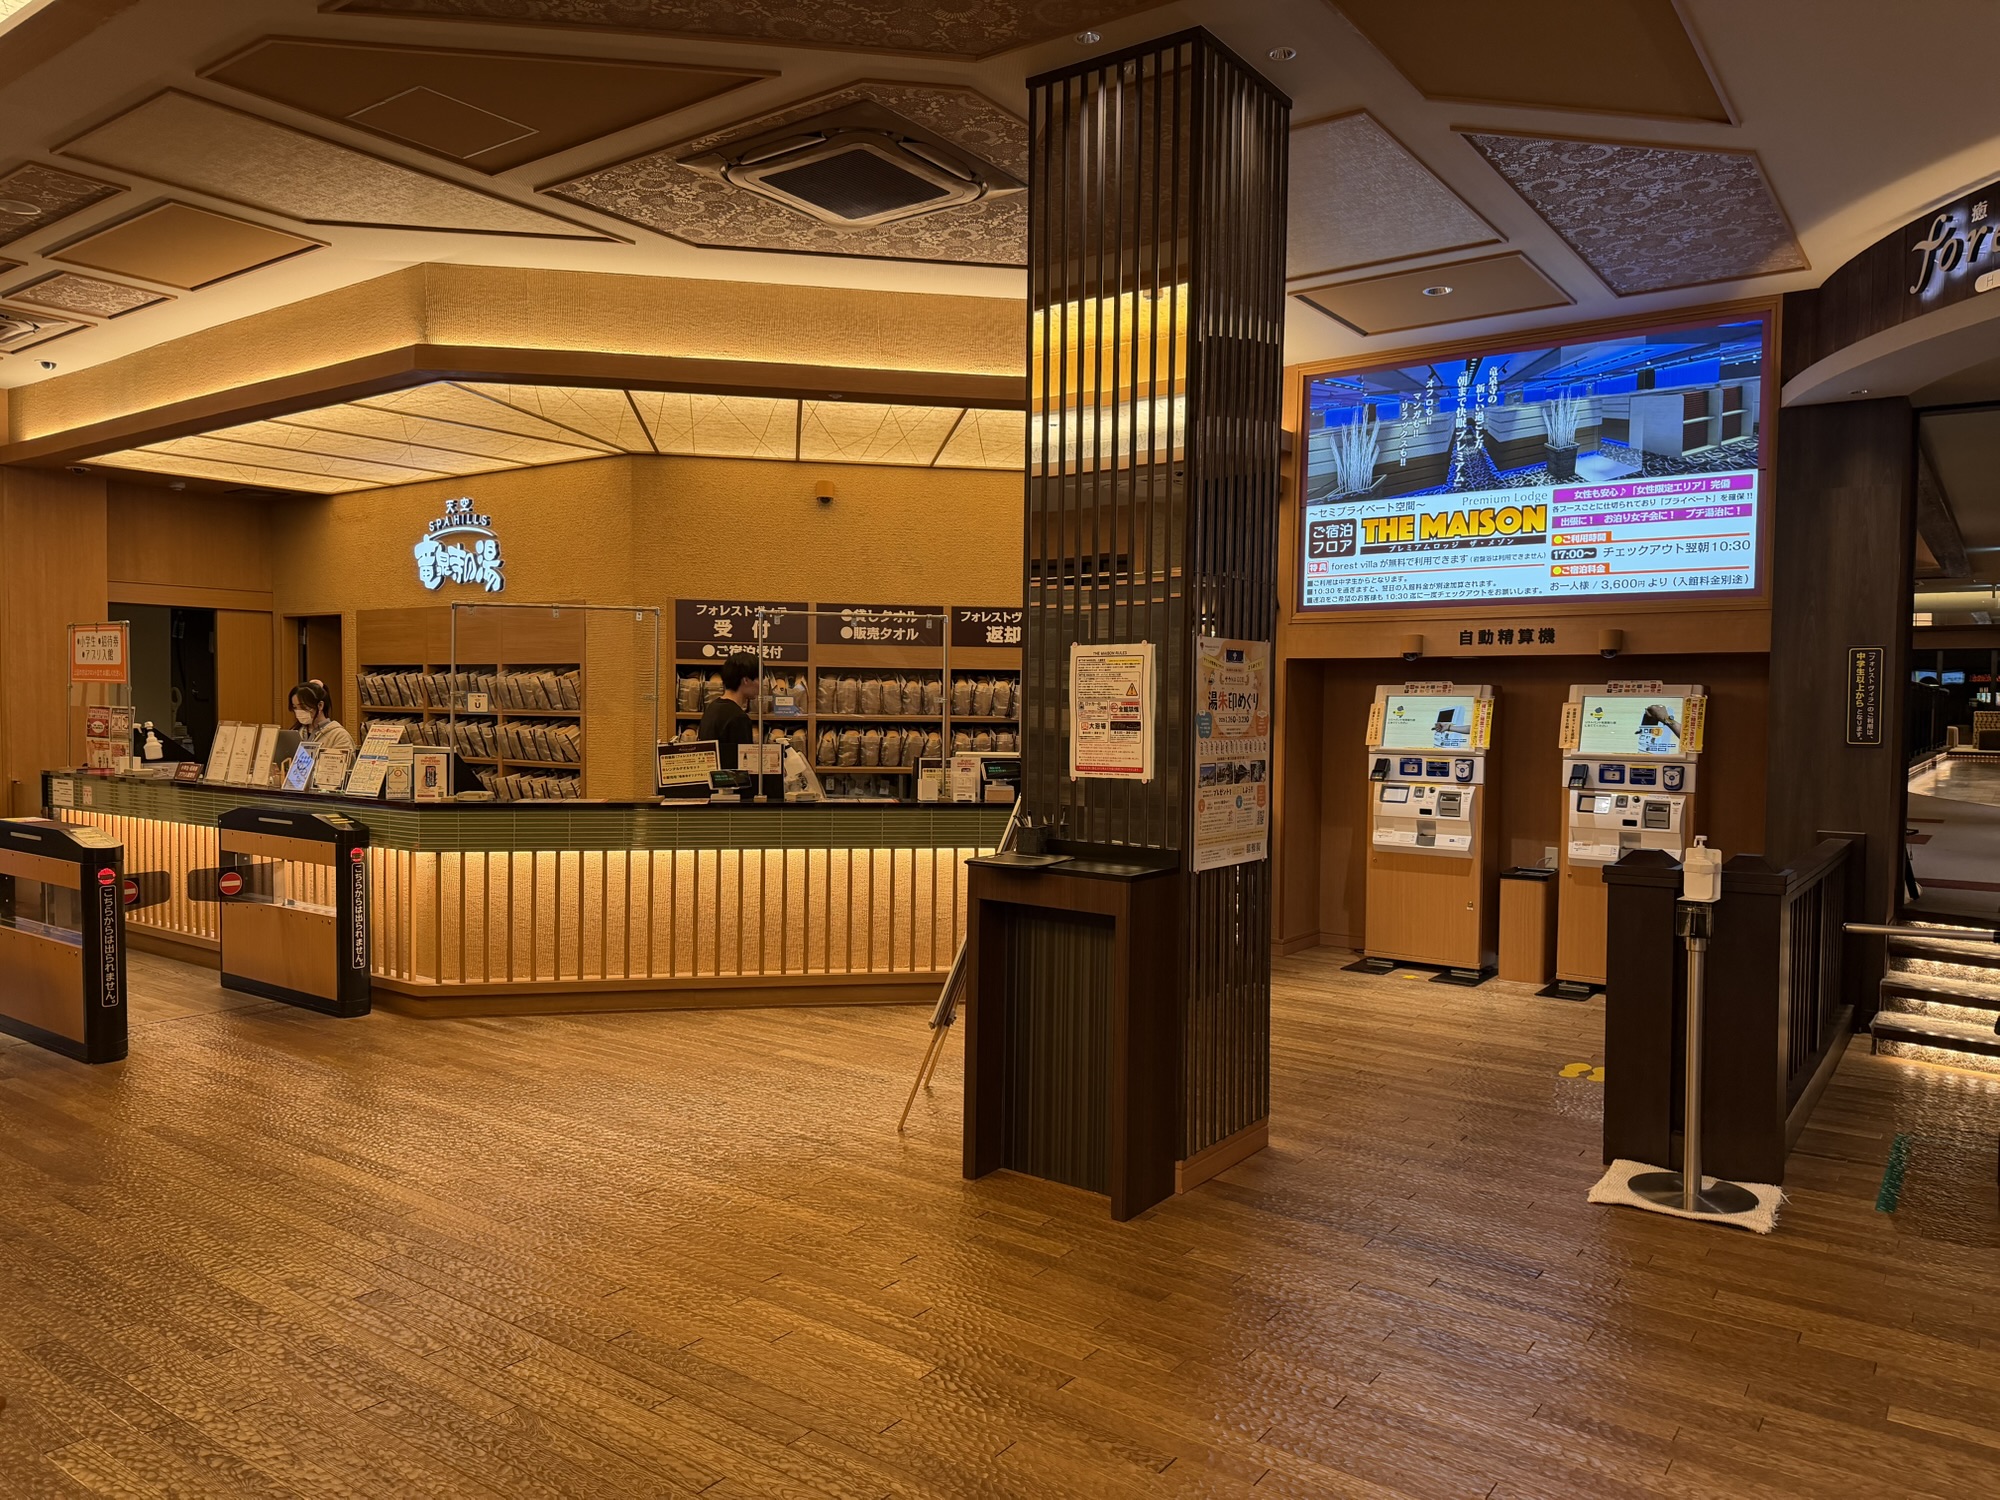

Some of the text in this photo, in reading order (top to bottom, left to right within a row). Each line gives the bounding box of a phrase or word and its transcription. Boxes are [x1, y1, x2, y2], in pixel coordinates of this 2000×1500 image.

[1971, 201, 1988, 223] 癒
[1488, 366, 1498, 403] 竜泉寺の
[1475, 383, 1485, 449] 新しい過ごし方
[445, 497, 473, 514] 天空
[1462, 491, 1548, 506] Premium Lodge
[428, 513, 490, 532] SPA HILLS
[1313, 523, 1354, 539] ご宿泊
[1361, 504, 1548, 544] THE MAISON
[1312, 539, 1353, 555] フロア
[1562, 534, 1607, 544] ご利用時間
[1331, 561, 1358, 570] forest
[1360, 560, 1378, 569] villa
[1380, 554, 1468, 567] が無料で利用できます
[1561, 564, 1606, 574] ご宿泊料金
[1313, 587, 1335, 596] 10:30
[1549, 581, 1590, 591] お一人様
[853, 627, 919, 641] 販売タオル
[985, 626, 1022, 643] 返却
[1459, 627, 1556, 647] 自動精算機
[1208, 690, 1259, 711] 湯朱印めぐり
[354, 864, 365, 966] こちらからは出られません。
[103, 887, 117, 1005] こちらからは出られません。
